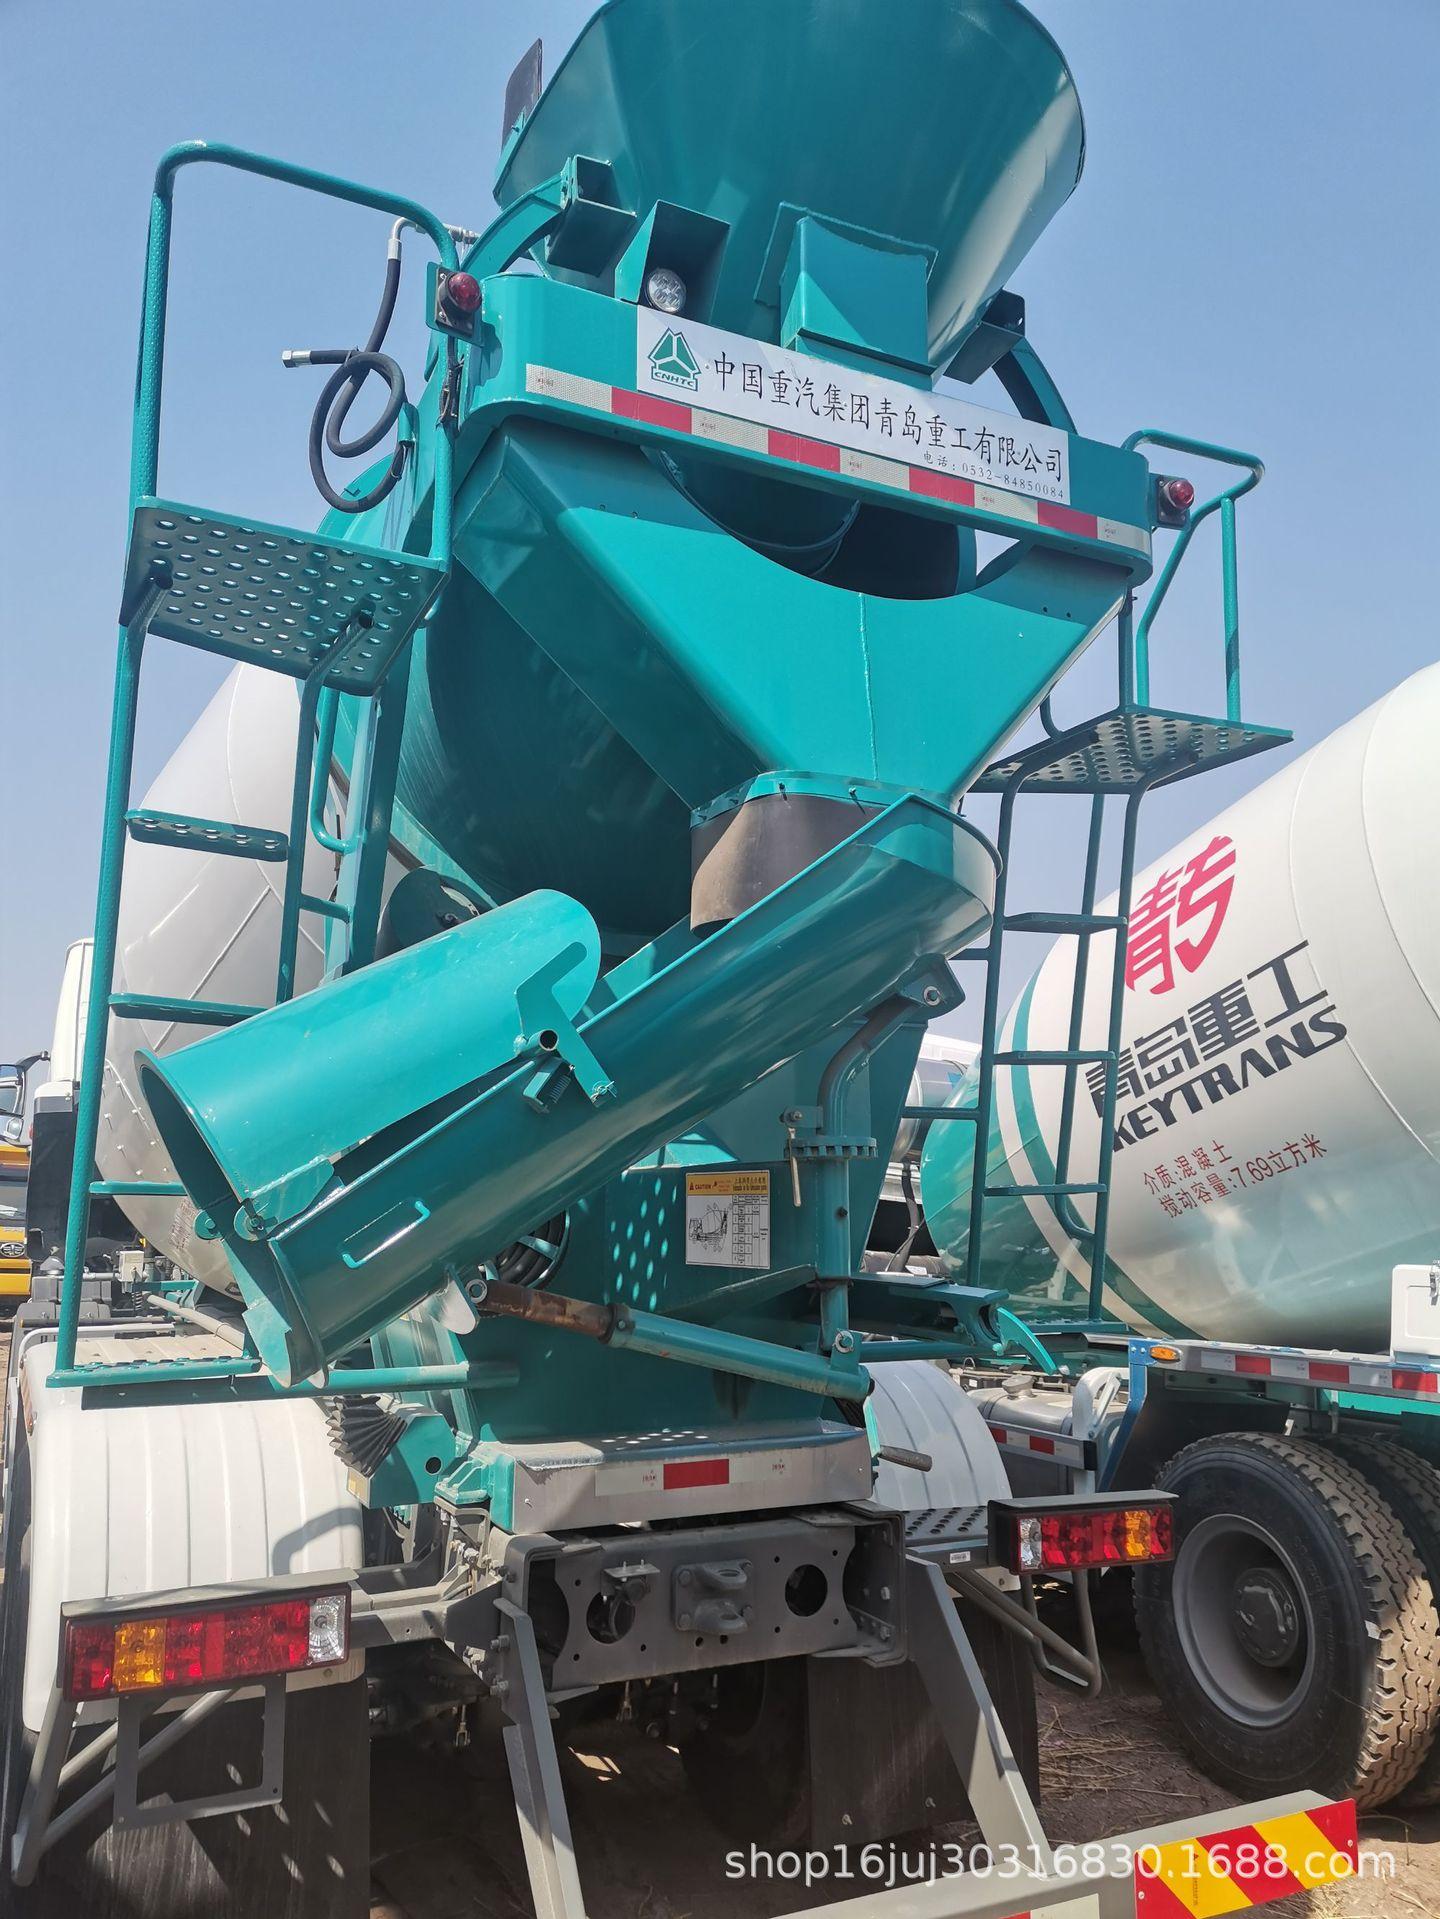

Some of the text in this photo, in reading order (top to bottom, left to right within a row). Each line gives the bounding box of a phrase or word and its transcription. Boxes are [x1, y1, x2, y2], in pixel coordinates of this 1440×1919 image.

[654, 371, 696, 388] CNHTC
[713, 351, 1062, 482] 中国重汽集团青岛重工有限公司
